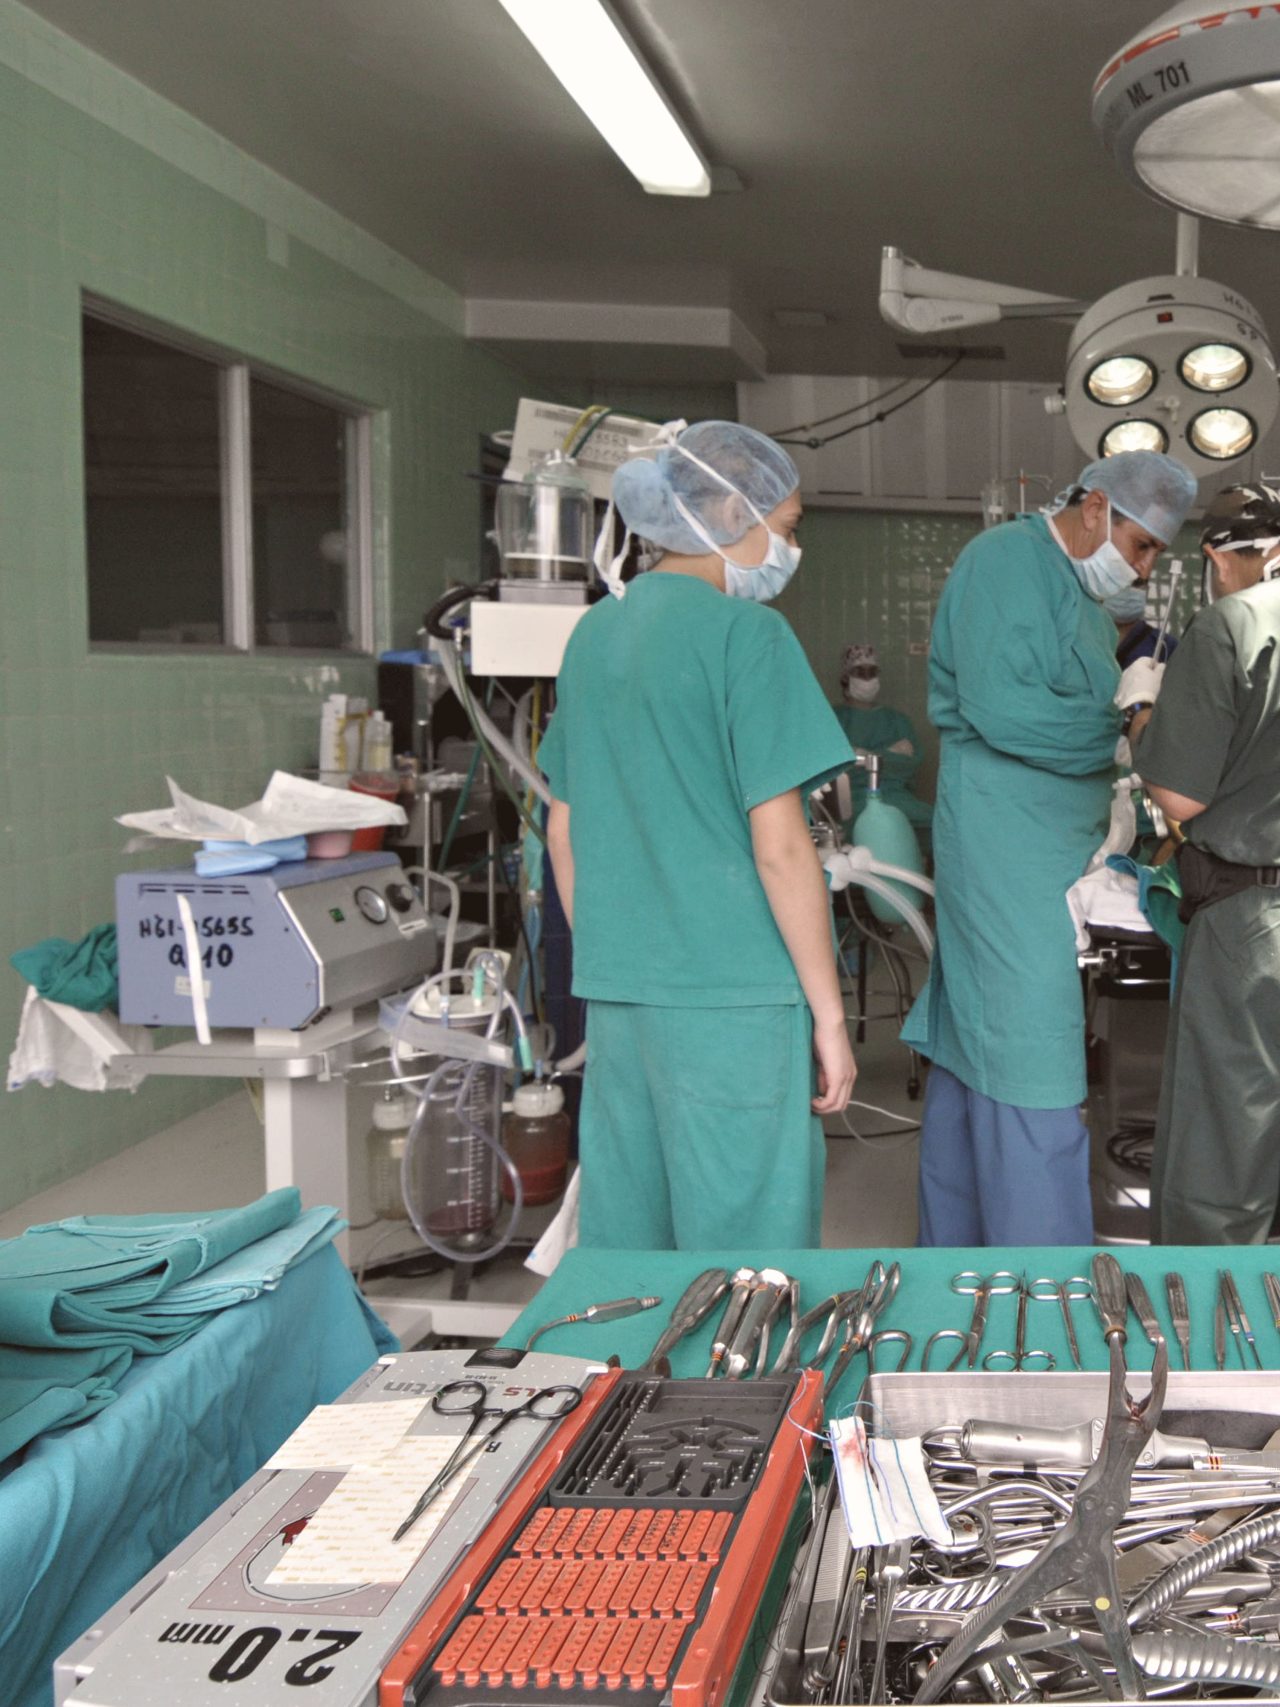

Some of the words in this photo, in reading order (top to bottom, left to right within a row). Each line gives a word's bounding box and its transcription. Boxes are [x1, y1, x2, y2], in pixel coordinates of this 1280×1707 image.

[1126, 81, 1153, 109] ML
[1154, 61, 1190, 92] 701
[502, 1386, 557, 1398] LS
